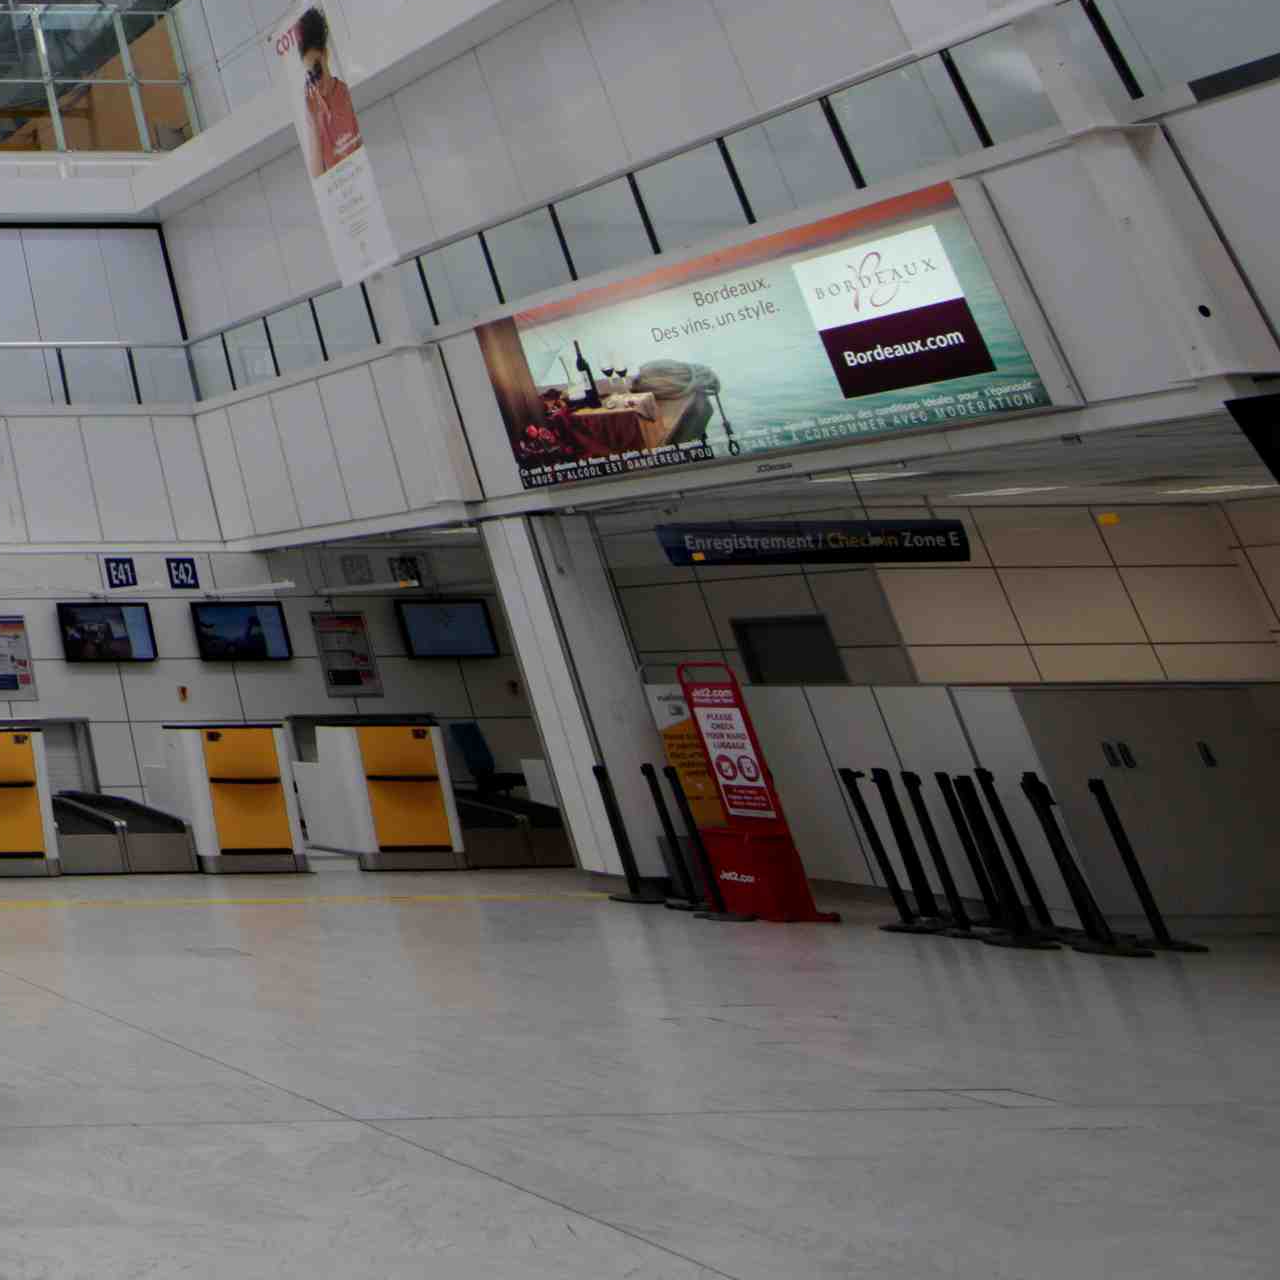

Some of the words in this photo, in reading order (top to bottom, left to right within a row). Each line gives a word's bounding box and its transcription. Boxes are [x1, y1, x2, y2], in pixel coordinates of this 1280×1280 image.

[815, 257, 937, 301] BORDEAUX
[693, 278, 771, 307] Bordeaux.
[651, 326, 680, 343] Des
[715, 310, 737, 327] un
[843, 330, 965, 368] Bordeaux.com
[684, 532, 817, 556] Enregistrement
[902, 531, 946, 548] Zone
[948, 531, 961, 548] E
[109, 560, 134, 586] E41
[170, 560, 196, 586] E42
[691, 687, 734, 698] Jet2.com
[706, 712, 733, 721] PLEASE
[711, 722, 734, 730] CHECK
[713, 742, 746, 750] LUGGAGE
